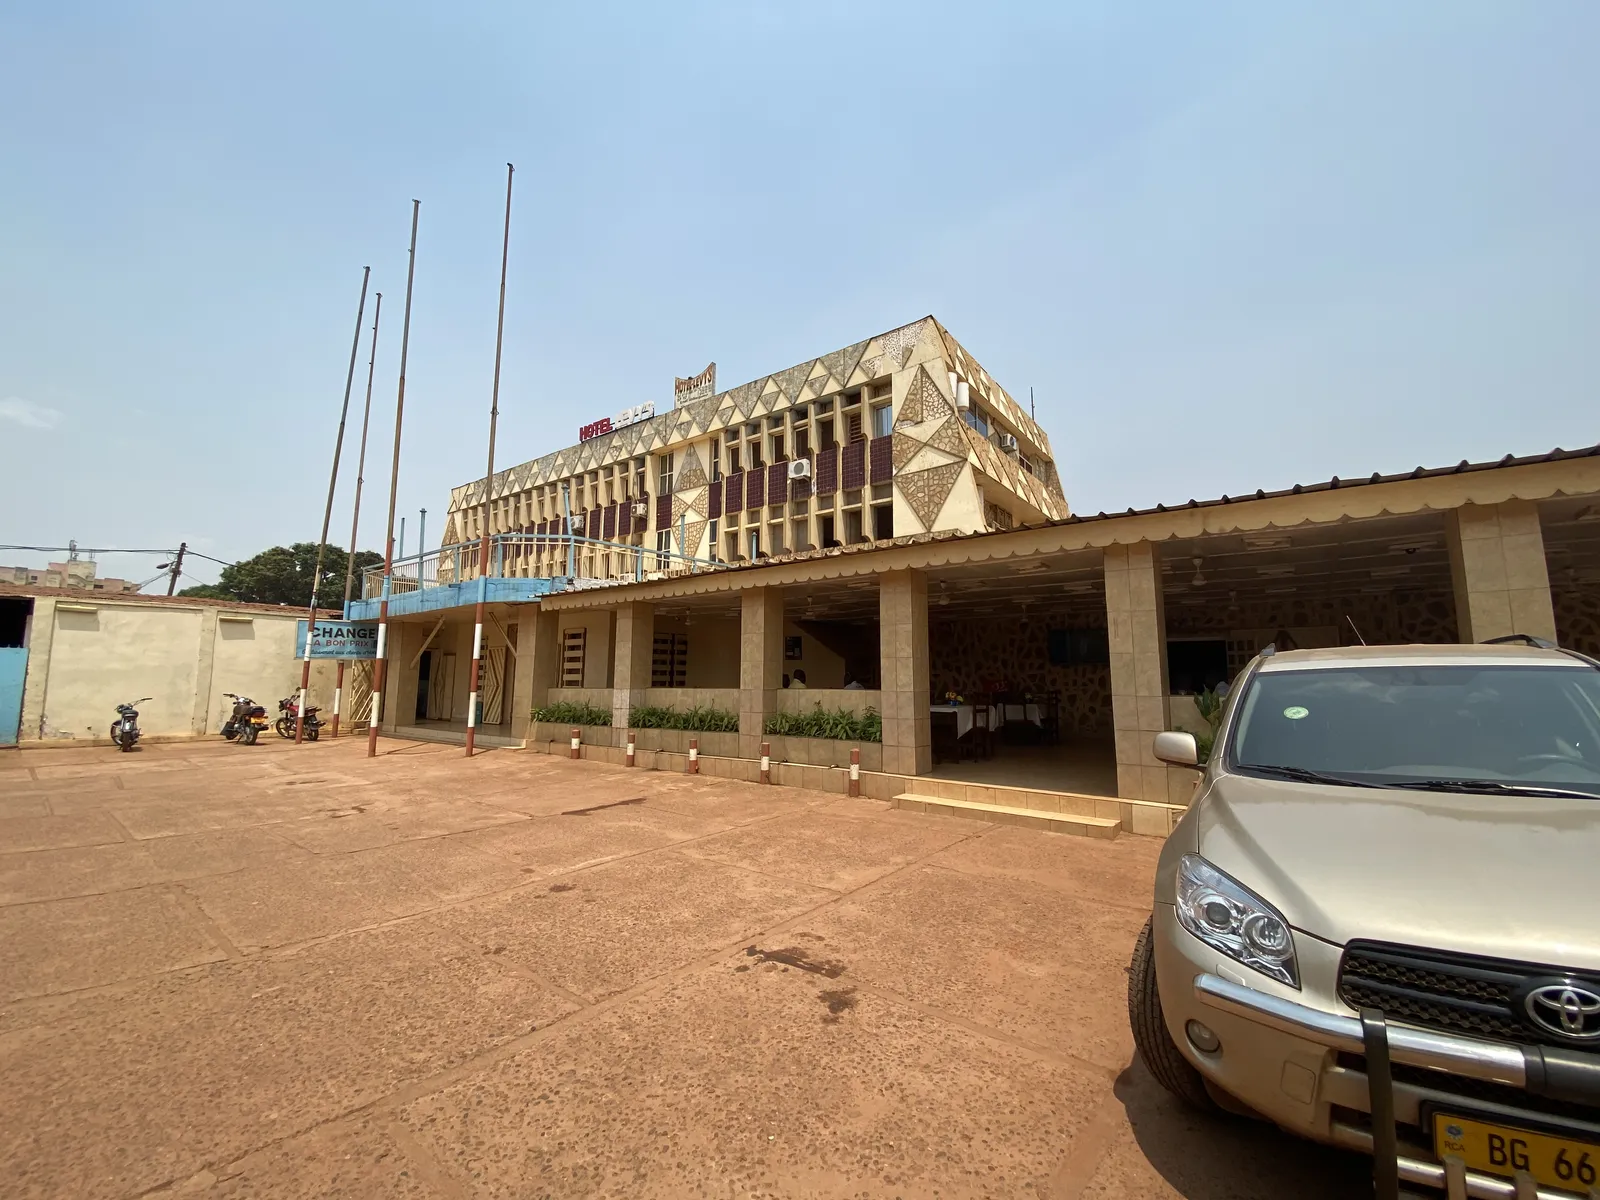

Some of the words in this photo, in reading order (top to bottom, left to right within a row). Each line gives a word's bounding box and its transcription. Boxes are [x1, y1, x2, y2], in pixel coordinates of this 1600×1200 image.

[580, 417, 613, 441] HOTEL
[312, 627, 375, 639] CHANGE
[325, 639, 346, 647] BON
[349, 640, 369, 648] PRIX
[1444, 1140, 1466, 1153] RCA
[1488, 1133, 1530, 1171] BG
